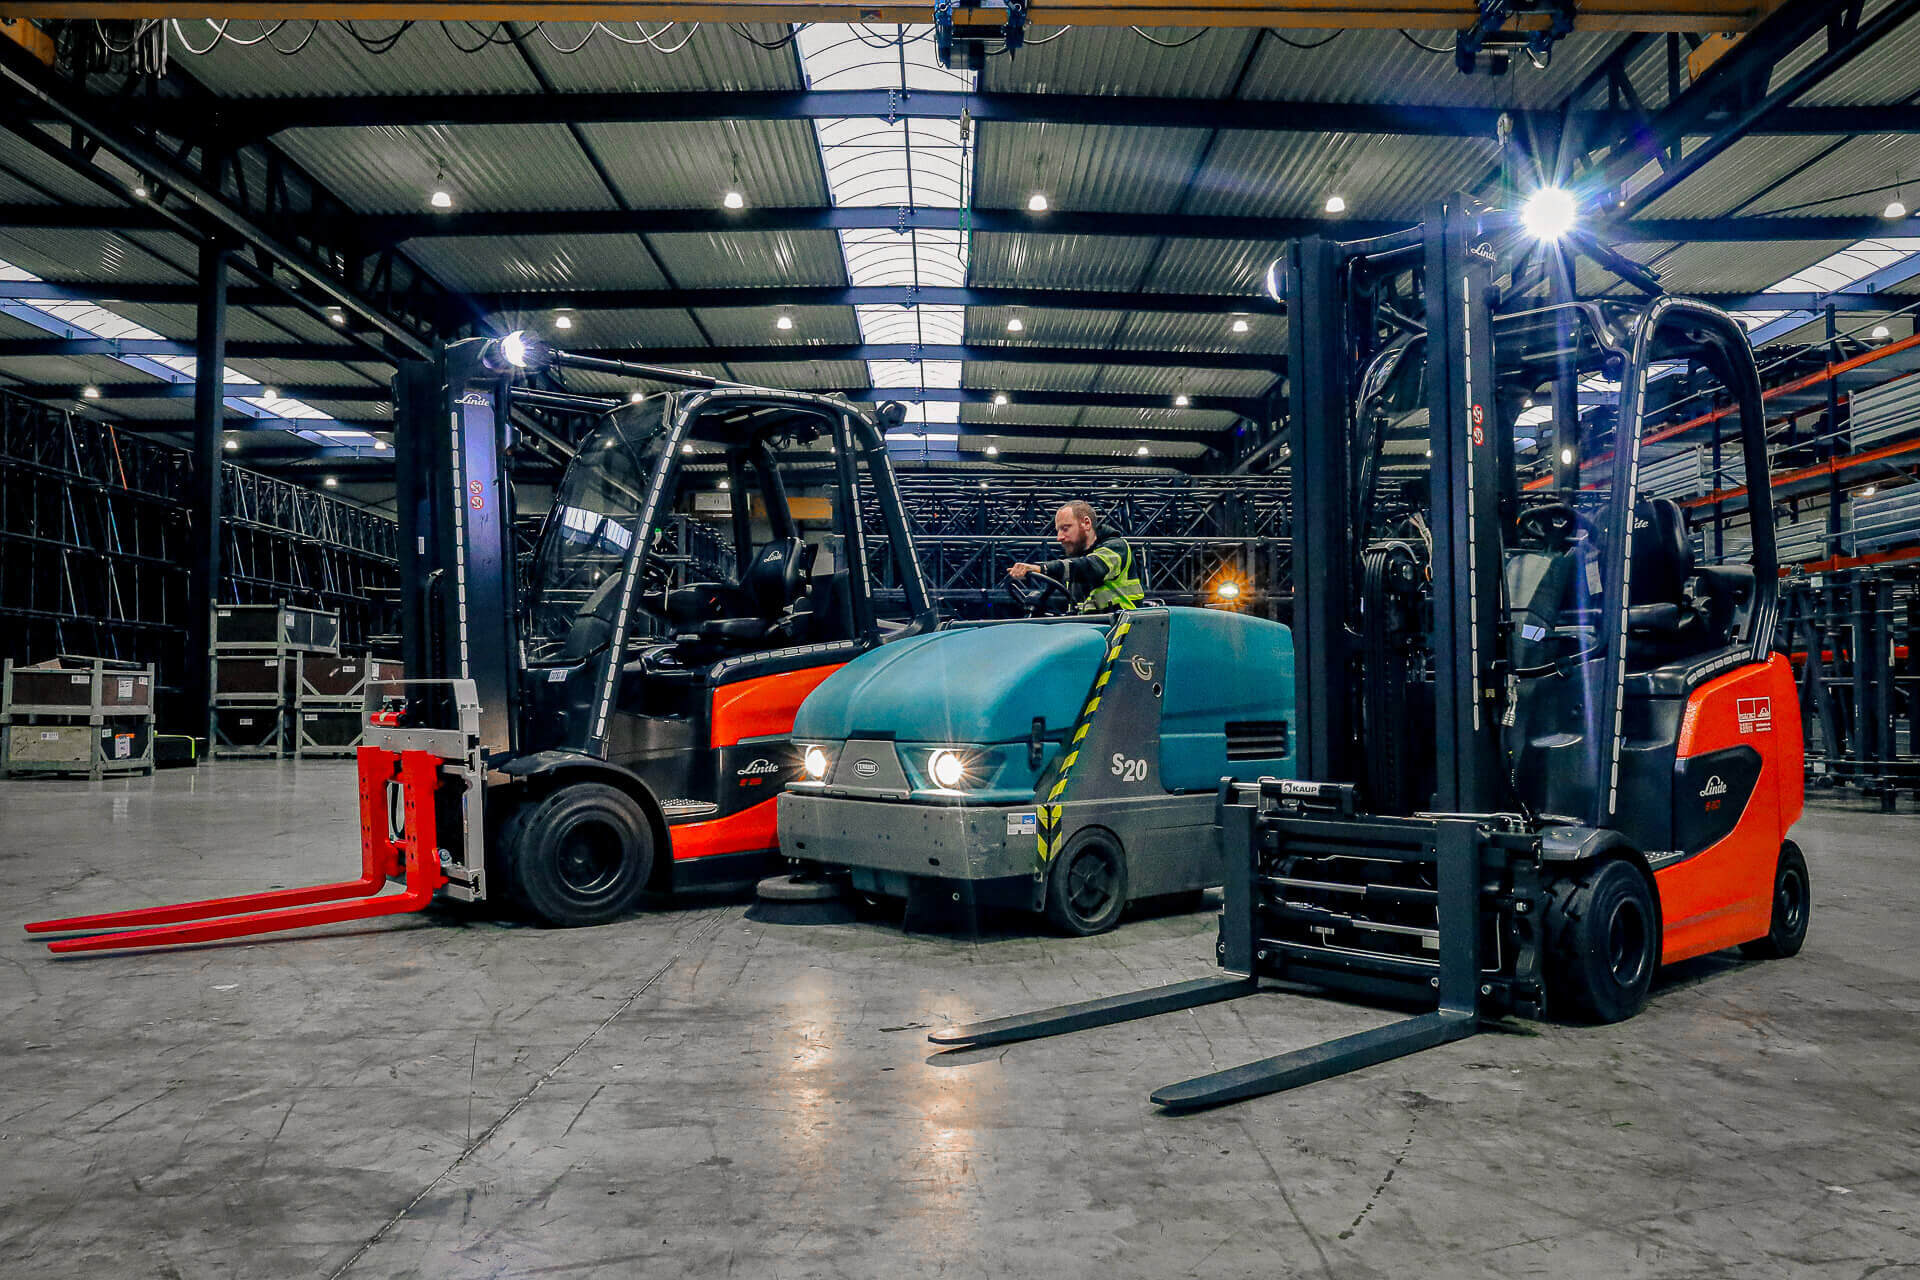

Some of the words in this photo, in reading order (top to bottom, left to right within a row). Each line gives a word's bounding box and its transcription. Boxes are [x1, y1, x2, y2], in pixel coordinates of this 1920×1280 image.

[454, 393, 490, 407] Linde
[737, 758, 779, 775] Linde
[1111, 752, 1148, 782] S20
[1292, 785, 1318, 793] KAUP
[1699, 775, 1728, 797] Linde
